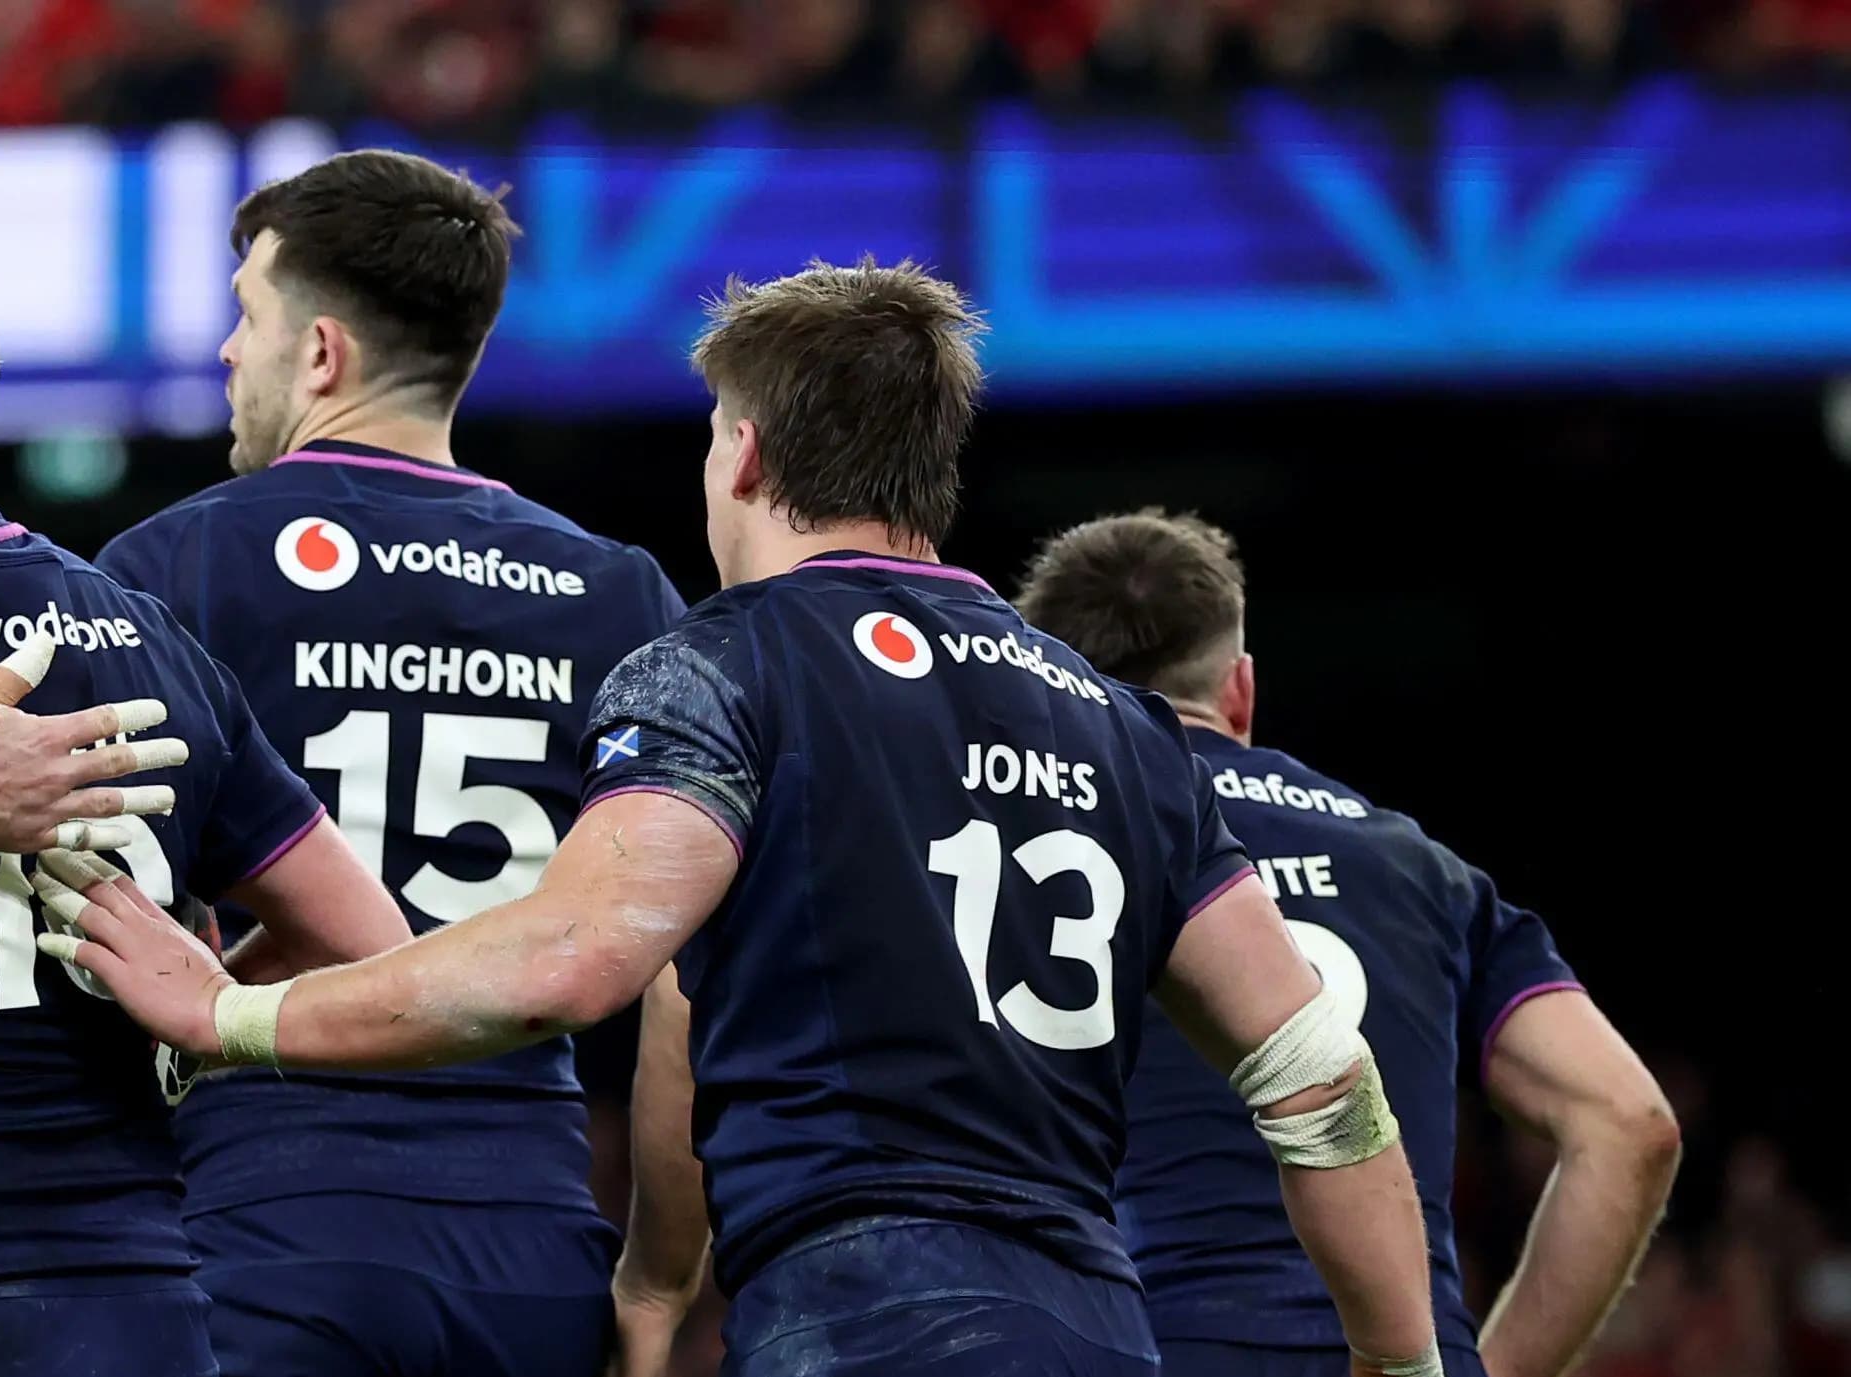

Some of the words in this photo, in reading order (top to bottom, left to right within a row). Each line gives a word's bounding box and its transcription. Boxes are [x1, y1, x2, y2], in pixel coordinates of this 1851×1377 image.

[370, 539, 588, 597] vodafone
[295, 641, 573, 704] KINGHORN
[961, 743, 1098, 811] JONES
[1212, 767, 1368, 819] dafone
[303, 710, 559, 925] 15
[1253, 854, 1339, 901] ITE
[927, 819, 1125, 1050] 13
